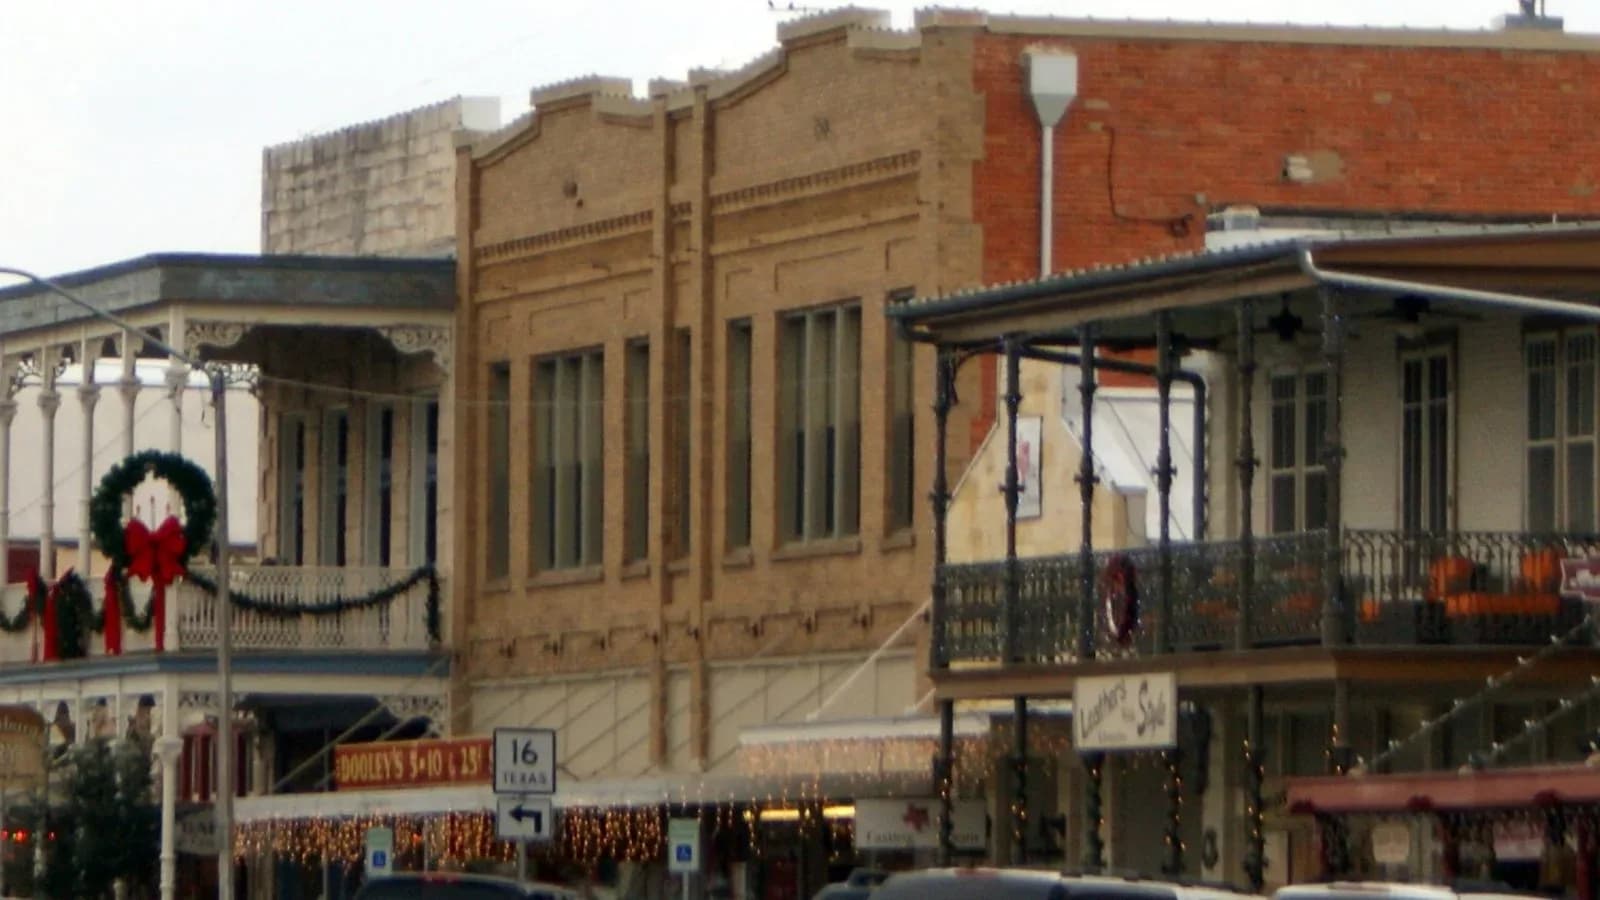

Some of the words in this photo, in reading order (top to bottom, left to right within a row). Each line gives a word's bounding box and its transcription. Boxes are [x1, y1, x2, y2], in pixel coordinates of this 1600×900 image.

[340, 747, 404, 783] DOOLEY'S
[512, 739, 538, 765] 16
[503, 771, 546, 785] TEXAS
